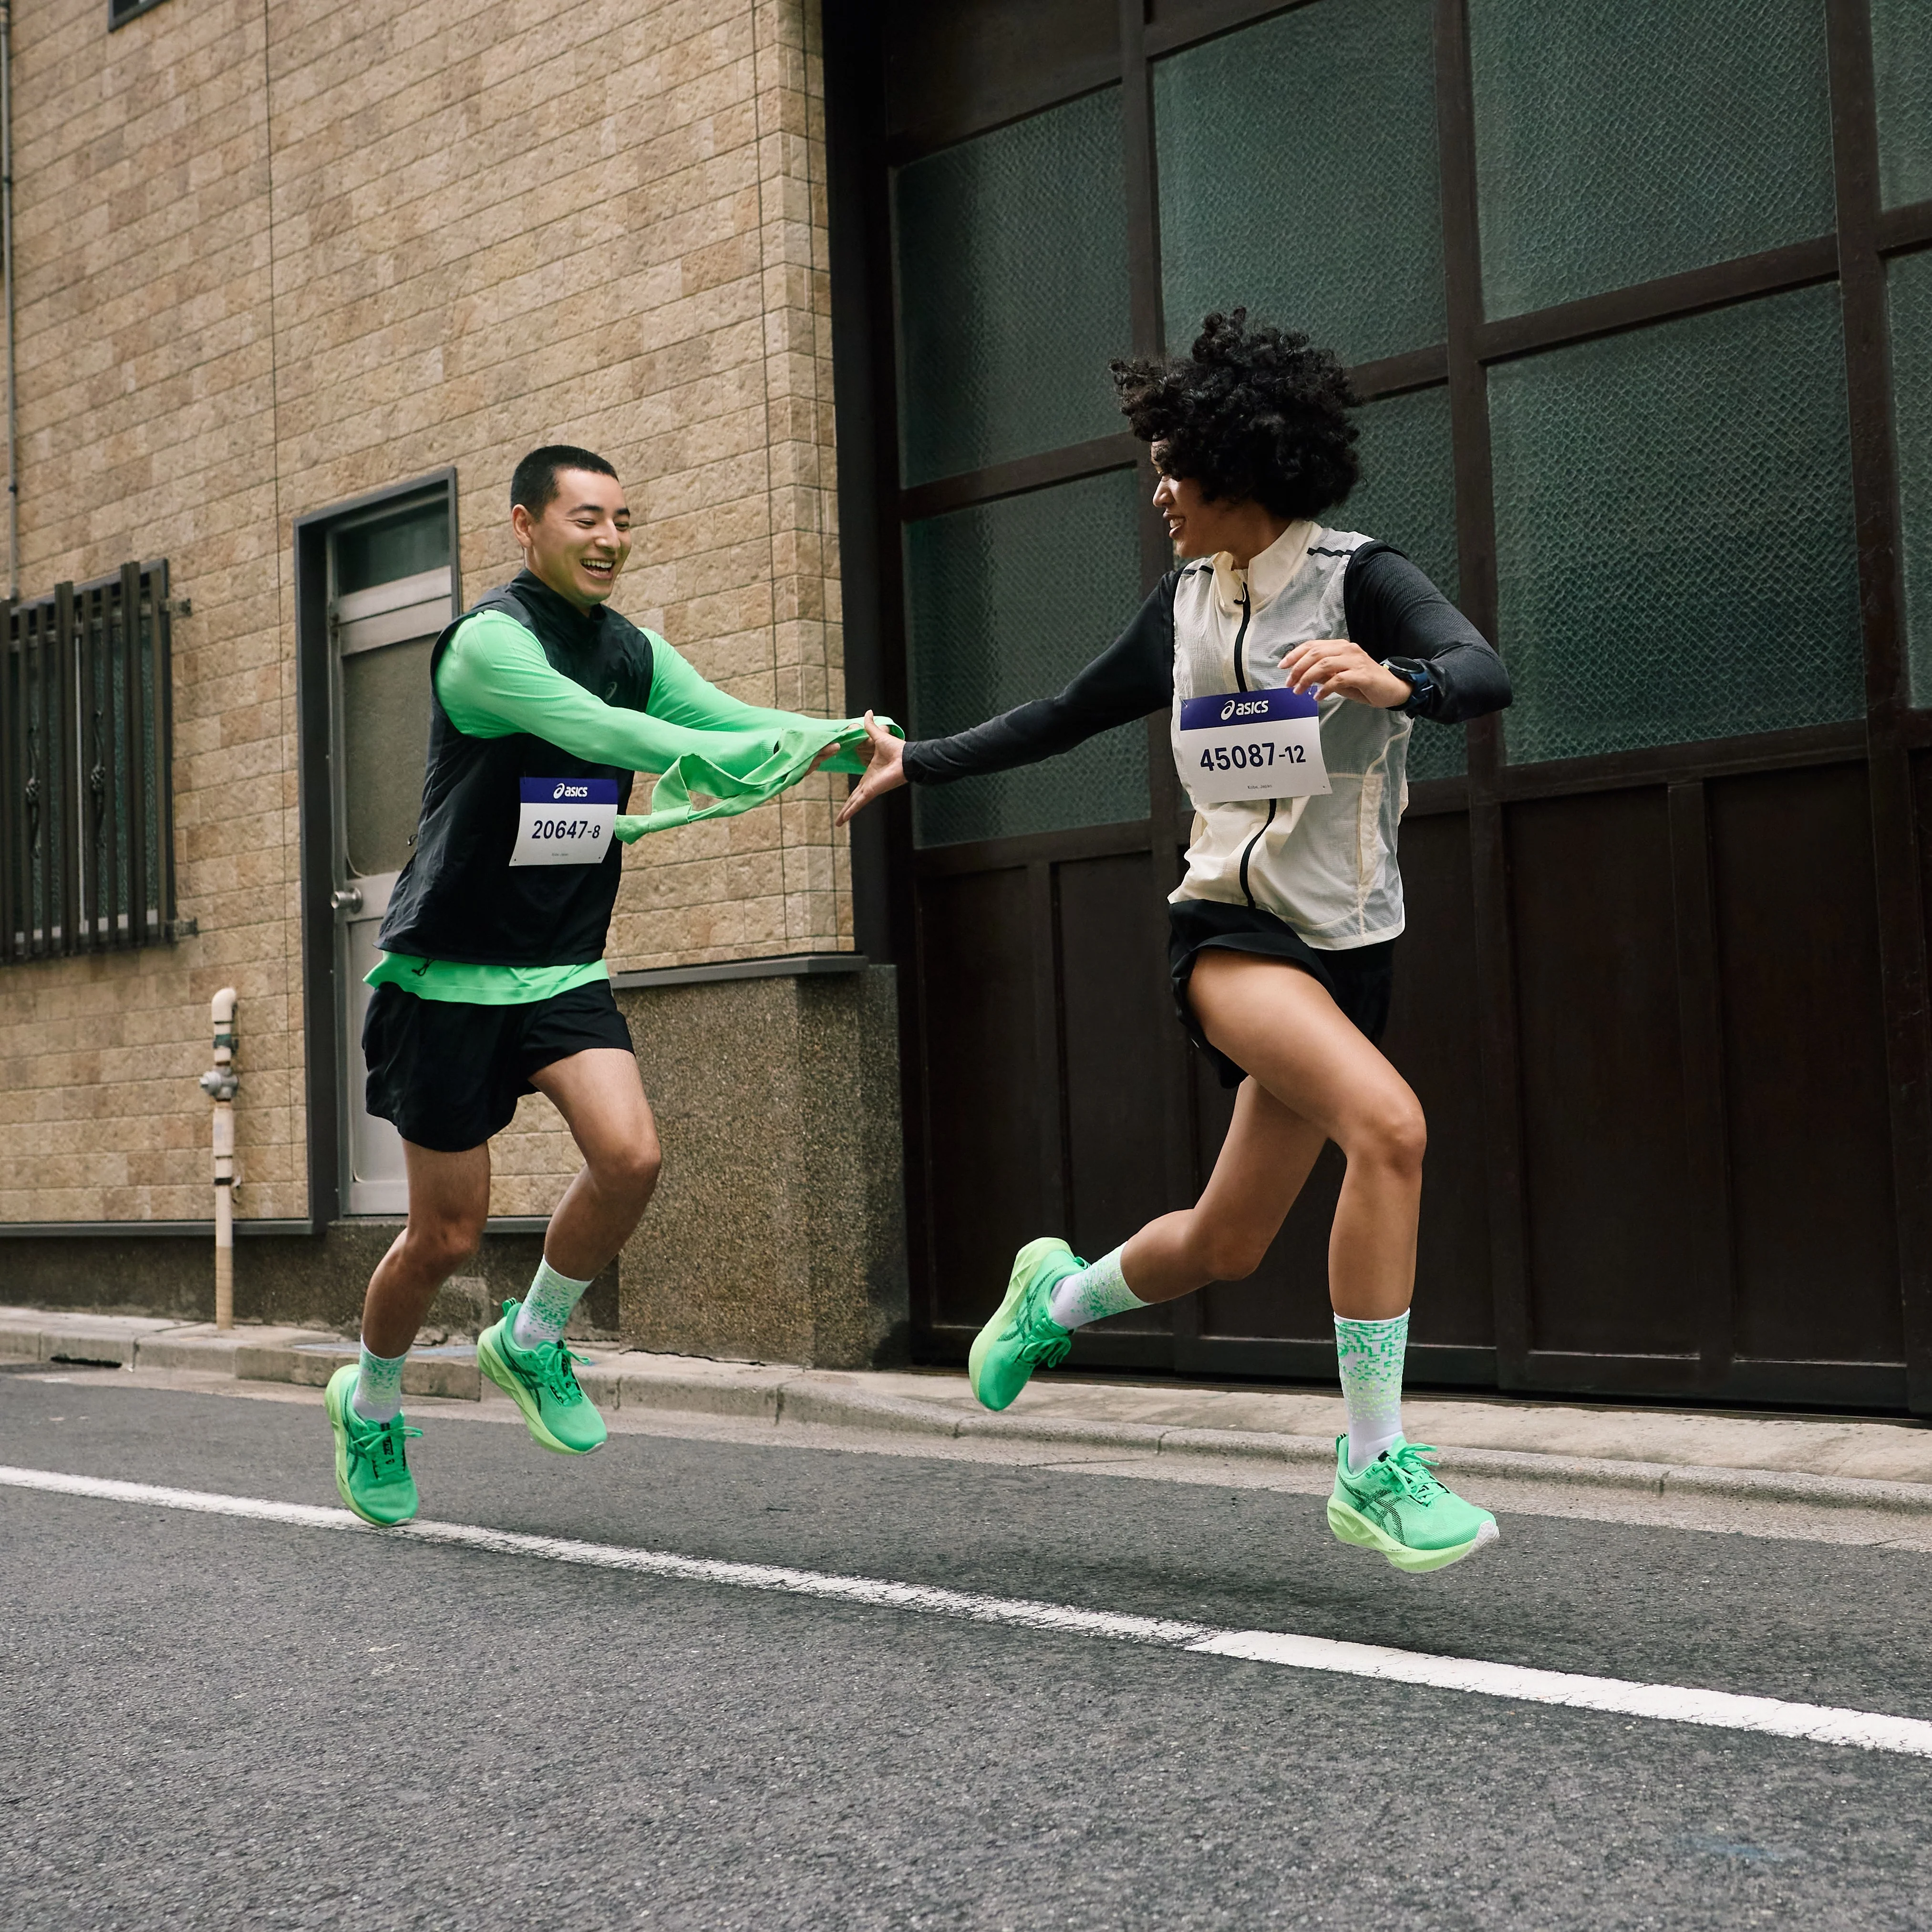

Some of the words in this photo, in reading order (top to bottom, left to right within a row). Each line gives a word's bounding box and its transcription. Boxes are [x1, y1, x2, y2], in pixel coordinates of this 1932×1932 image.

[1236, 700, 1269, 715] asics
[1200, 743, 1306, 771] 45087-12
[565, 786, 588, 797] asics
[532, 820, 600, 839] 20647-8
